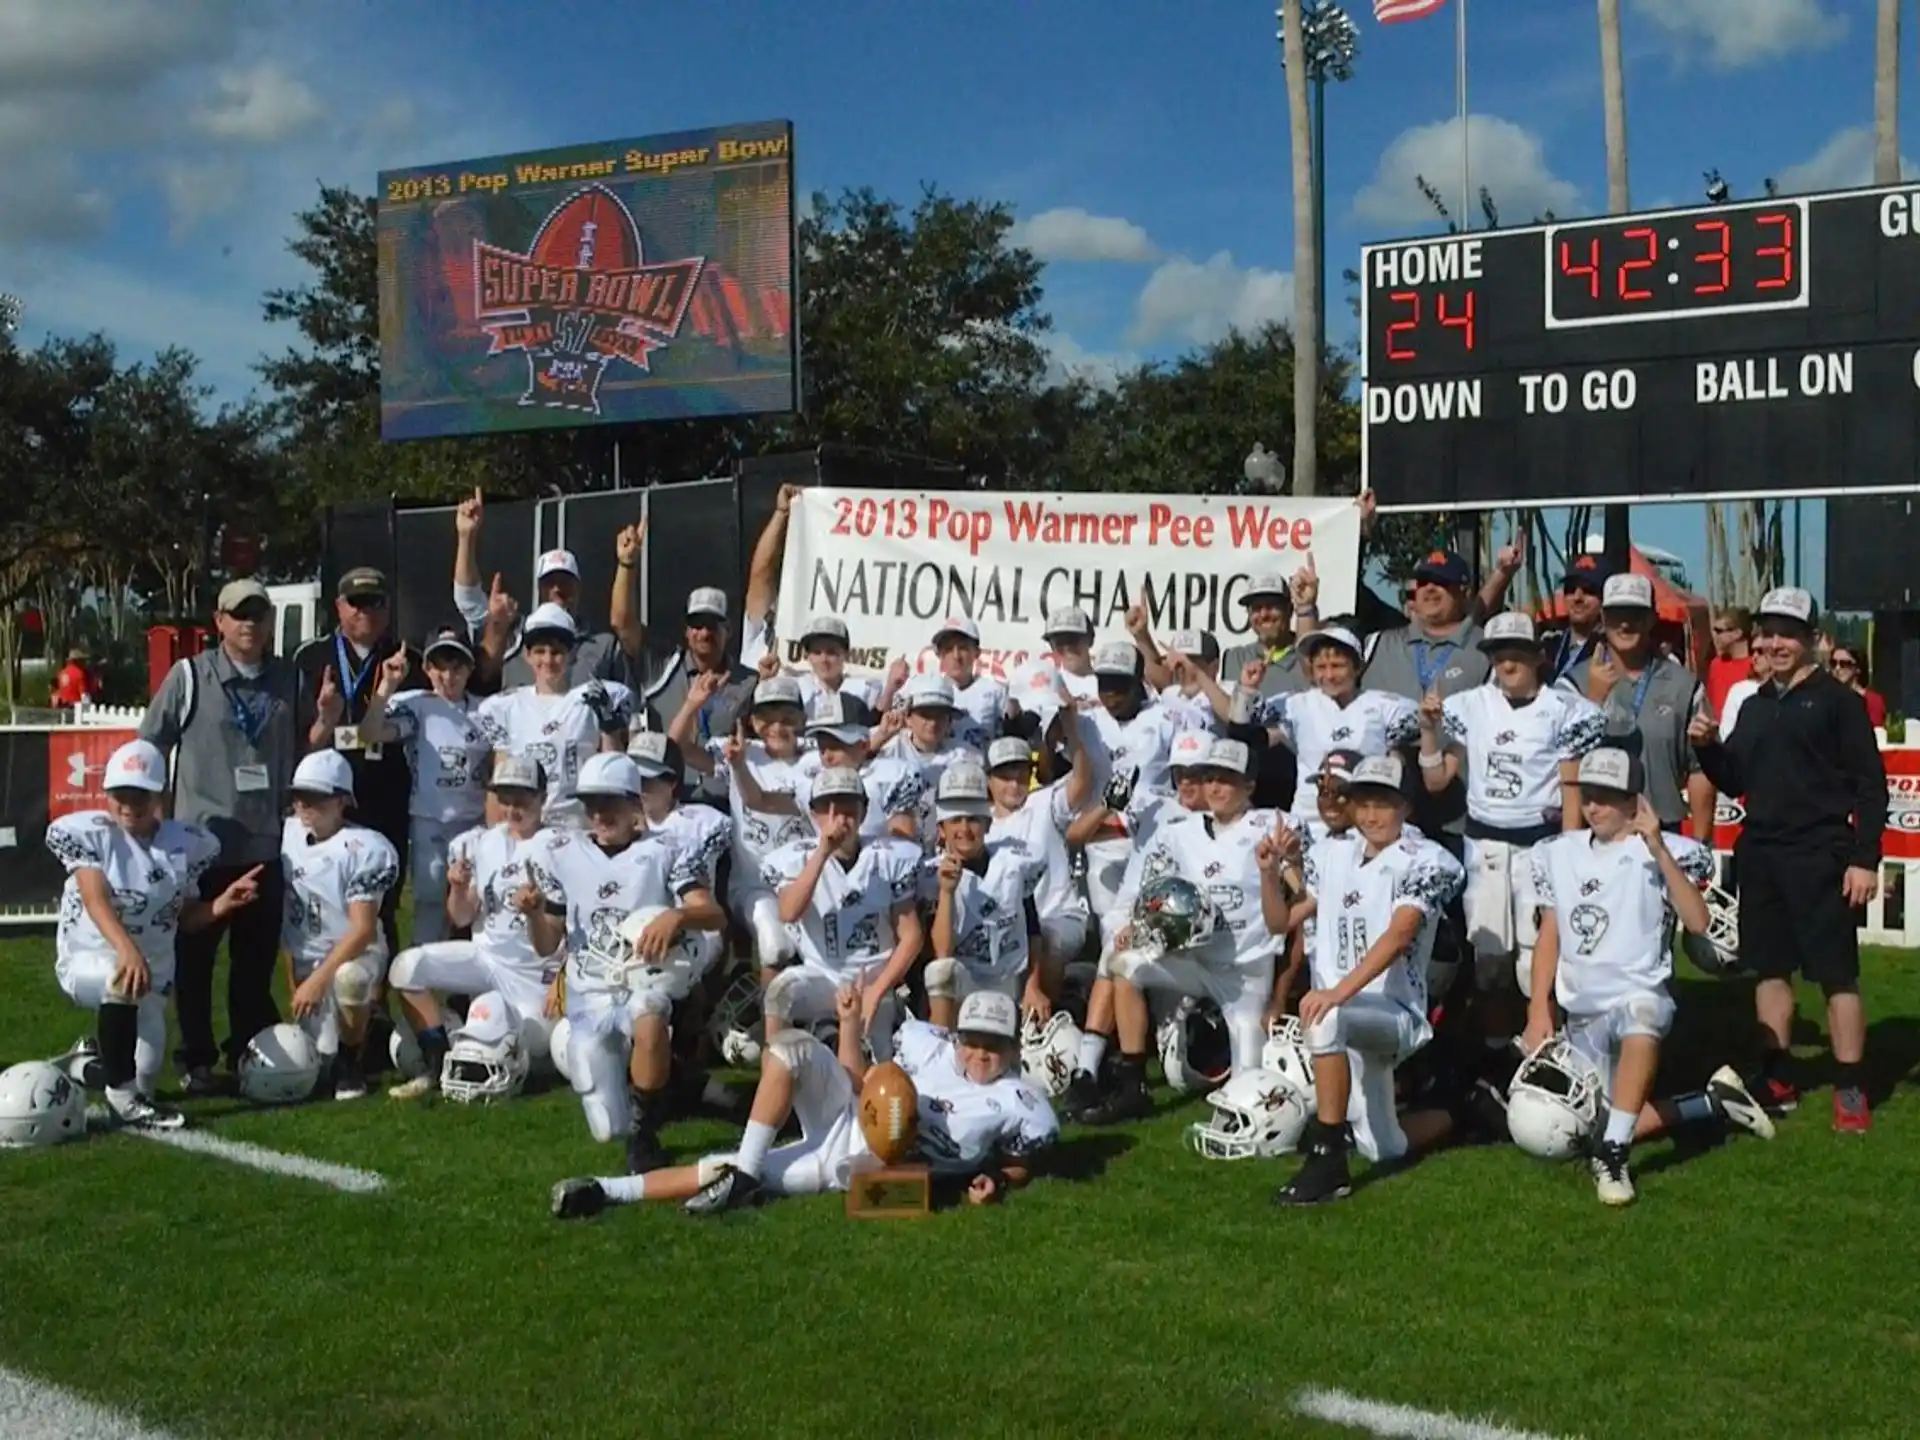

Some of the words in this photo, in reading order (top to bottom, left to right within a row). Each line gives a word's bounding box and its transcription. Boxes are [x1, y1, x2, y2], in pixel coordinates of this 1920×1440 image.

[388, 174, 451, 200] 2013
[459, 171, 509, 194] Pop
[515, 159, 617, 184] Warner
[625, 147, 710, 174] Super
[718, 134, 788, 163] Bowl
[1375, 241, 1483, 288] HOME
[1561, 214, 1792, 301] 42:33
[484, 255, 580, 304] SUPER
[586, 271, 678, 319] BOWL
[1386, 291, 1476, 360] 24
[1369, 379, 1483, 424] DOWN
[1519, 373, 1568, 414] TO
[1582, 369, 1637, 411] GO
[1696, 357, 1788, 404] BALL
[1799, 352, 1853, 396] ON
[830, 497, 919, 538] 2013
[928, 499, 993, 556] Pop
[1003, 500, 1138, 546] Warner
[1149, 503, 1213, 548] Pee
[1227, 506, 1312, 552] Wee
[810, 557, 1030, 623] NATIONAL
[1484, 752, 1523, 799] 5
[1570, 904, 1609, 956] 9
